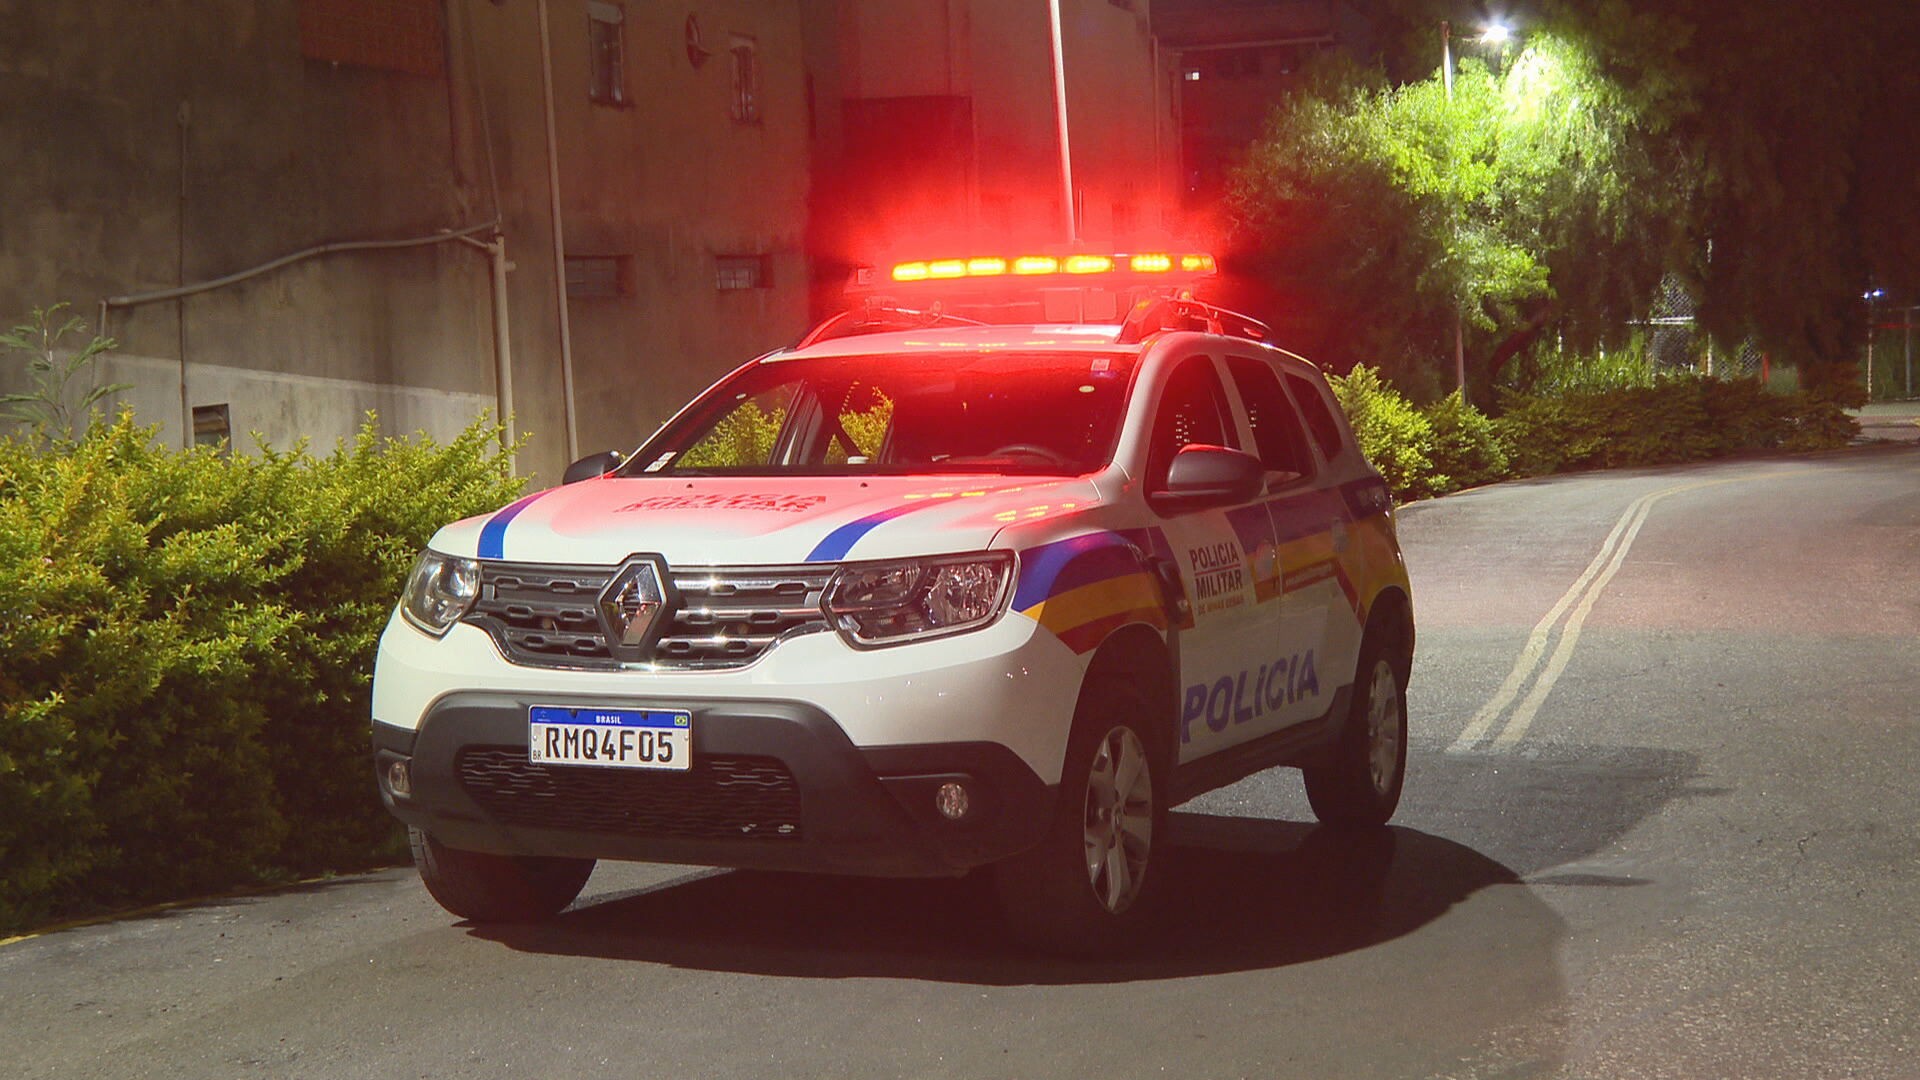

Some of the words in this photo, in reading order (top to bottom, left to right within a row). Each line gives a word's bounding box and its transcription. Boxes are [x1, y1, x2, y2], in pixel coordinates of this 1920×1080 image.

[1195, 569, 1243, 600] MILITAR
[596, 715, 622, 724] BRASIL
[545, 727, 673, 763] RMQ4F05
